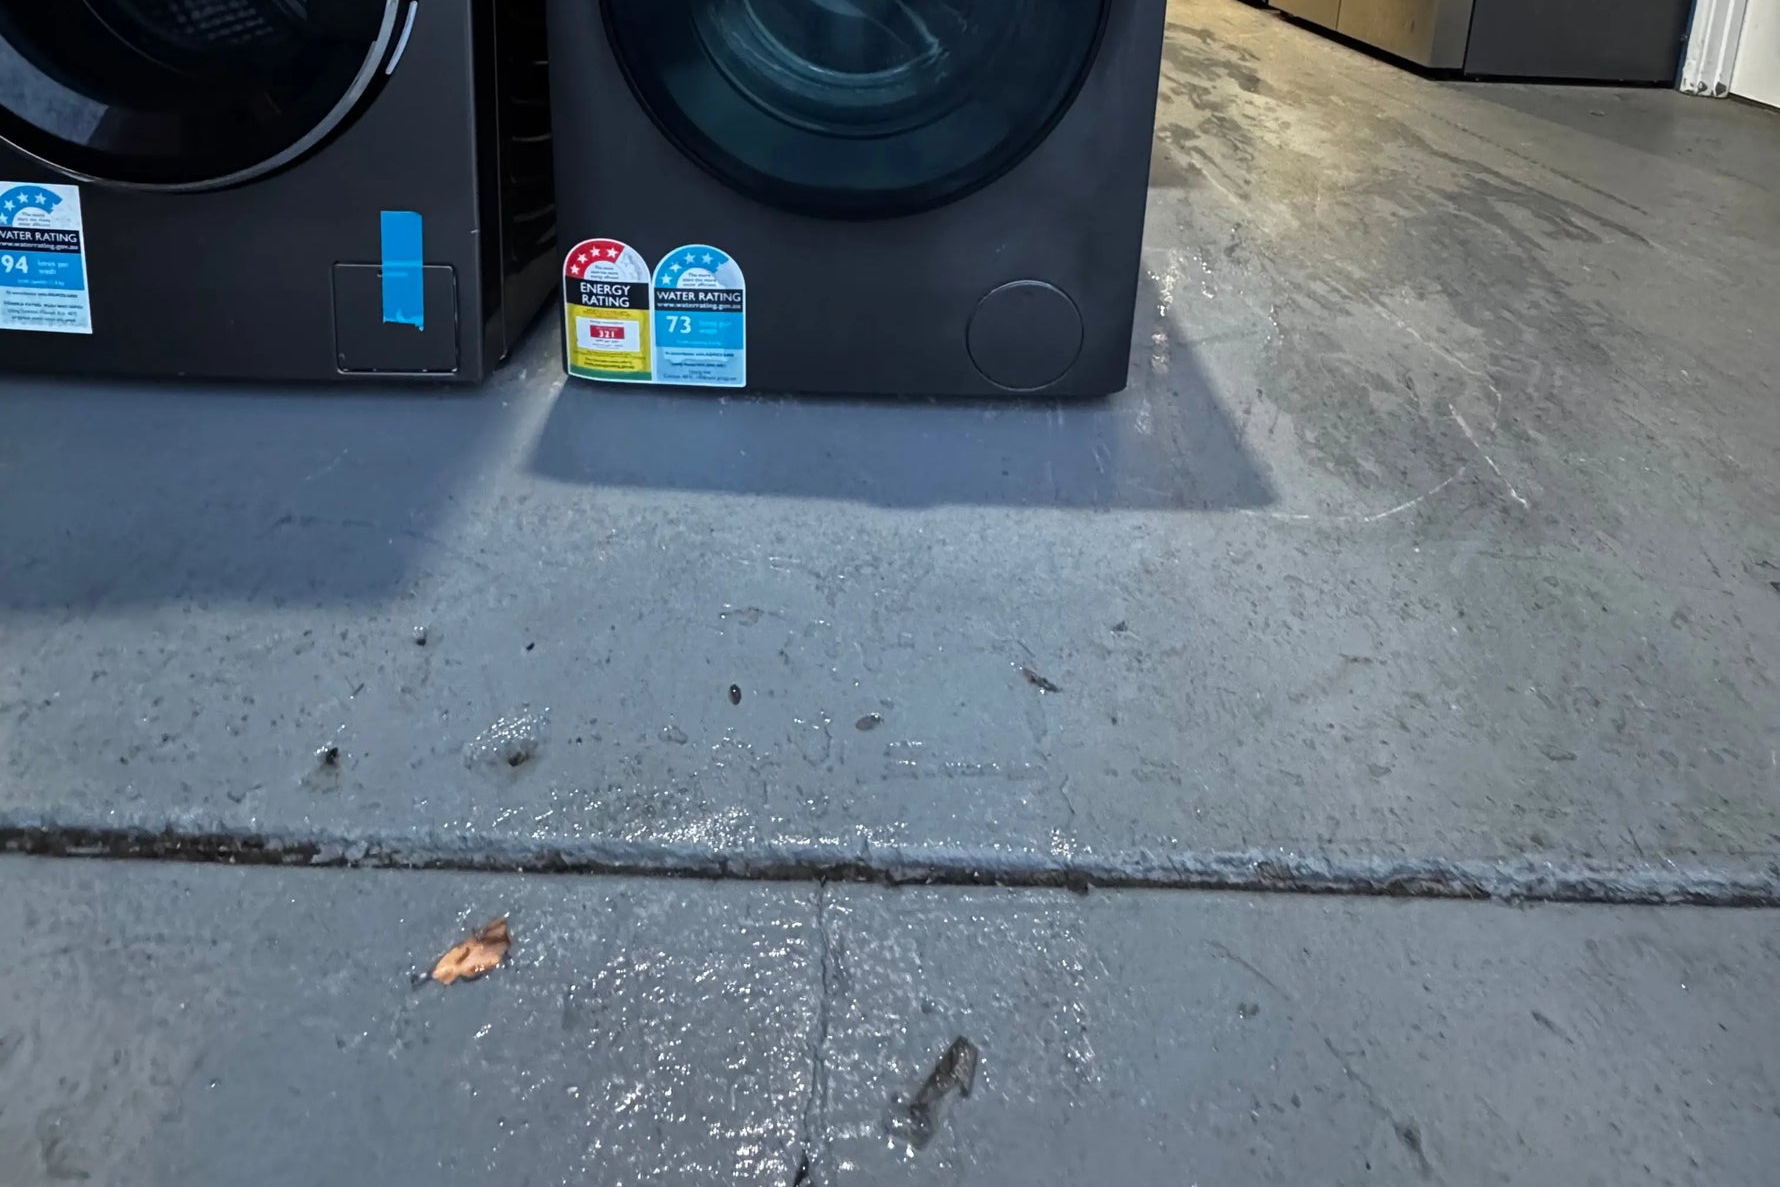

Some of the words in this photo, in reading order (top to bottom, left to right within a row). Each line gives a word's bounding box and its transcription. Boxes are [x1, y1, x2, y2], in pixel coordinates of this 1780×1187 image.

[35, 232, 77, 243] RATING
[1, 255, 28, 274] 94
[580, 282, 630, 295] ENERGY
[582, 294, 629, 307] RATING
[656, 291, 695, 301] WATER
[698, 292, 741, 302] RATING
[666, 315, 691, 334] 73
[598, 330, 615, 338] 321
